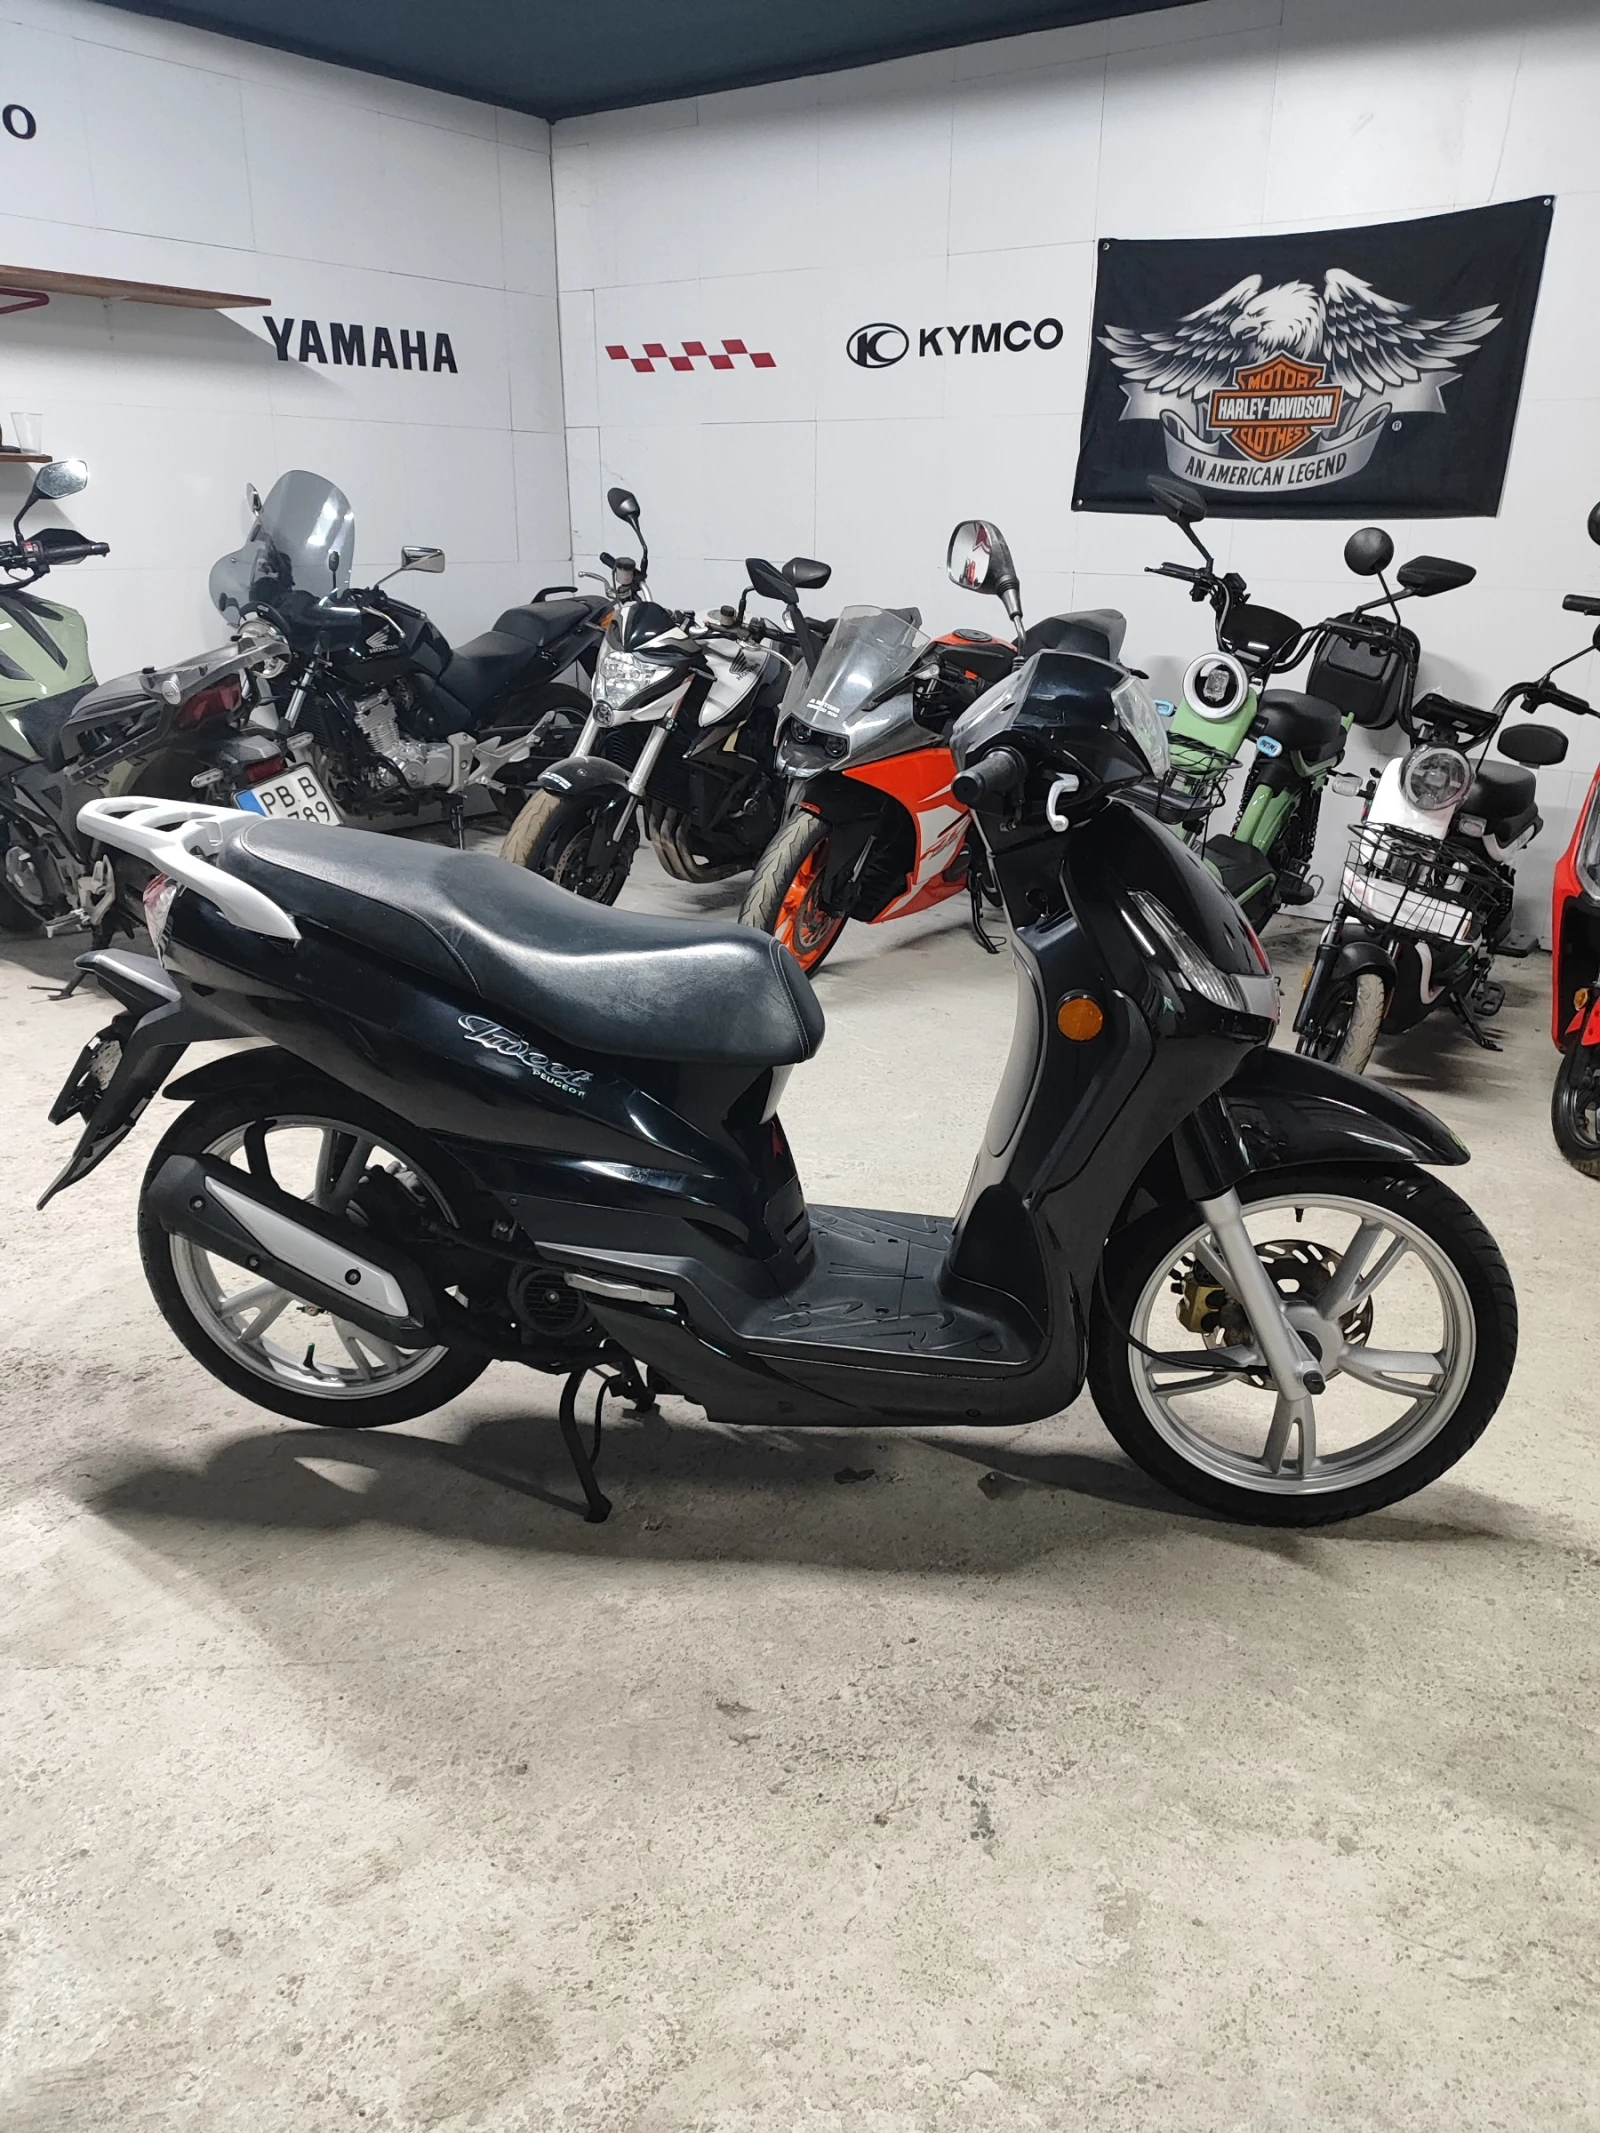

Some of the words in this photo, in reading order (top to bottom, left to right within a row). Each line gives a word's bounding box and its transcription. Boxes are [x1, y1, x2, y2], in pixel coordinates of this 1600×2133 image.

[262, 315, 459, 374] YAMAHA
[919, 317, 1064, 357] KYMCO
[1247, 363, 1311, 390] MOTOR
[1217, 394, 1334, 420] HARLEY-DAVIDSON
[1240, 427, 1301, 456] CLOTHES
[1185, 455, 1207, 481] AN
[1207, 462, 1285, 487] AMERICAN
[1287, 452, 1347, 485] LEGEND
[368, 644, 399, 654] HONDA
[259, 785, 296, 815] PB
[297, 776, 318, 799] B
[457, 1014, 594, 1088] Tweet
[532, 1068, 586, 1100] PEUGEOT
